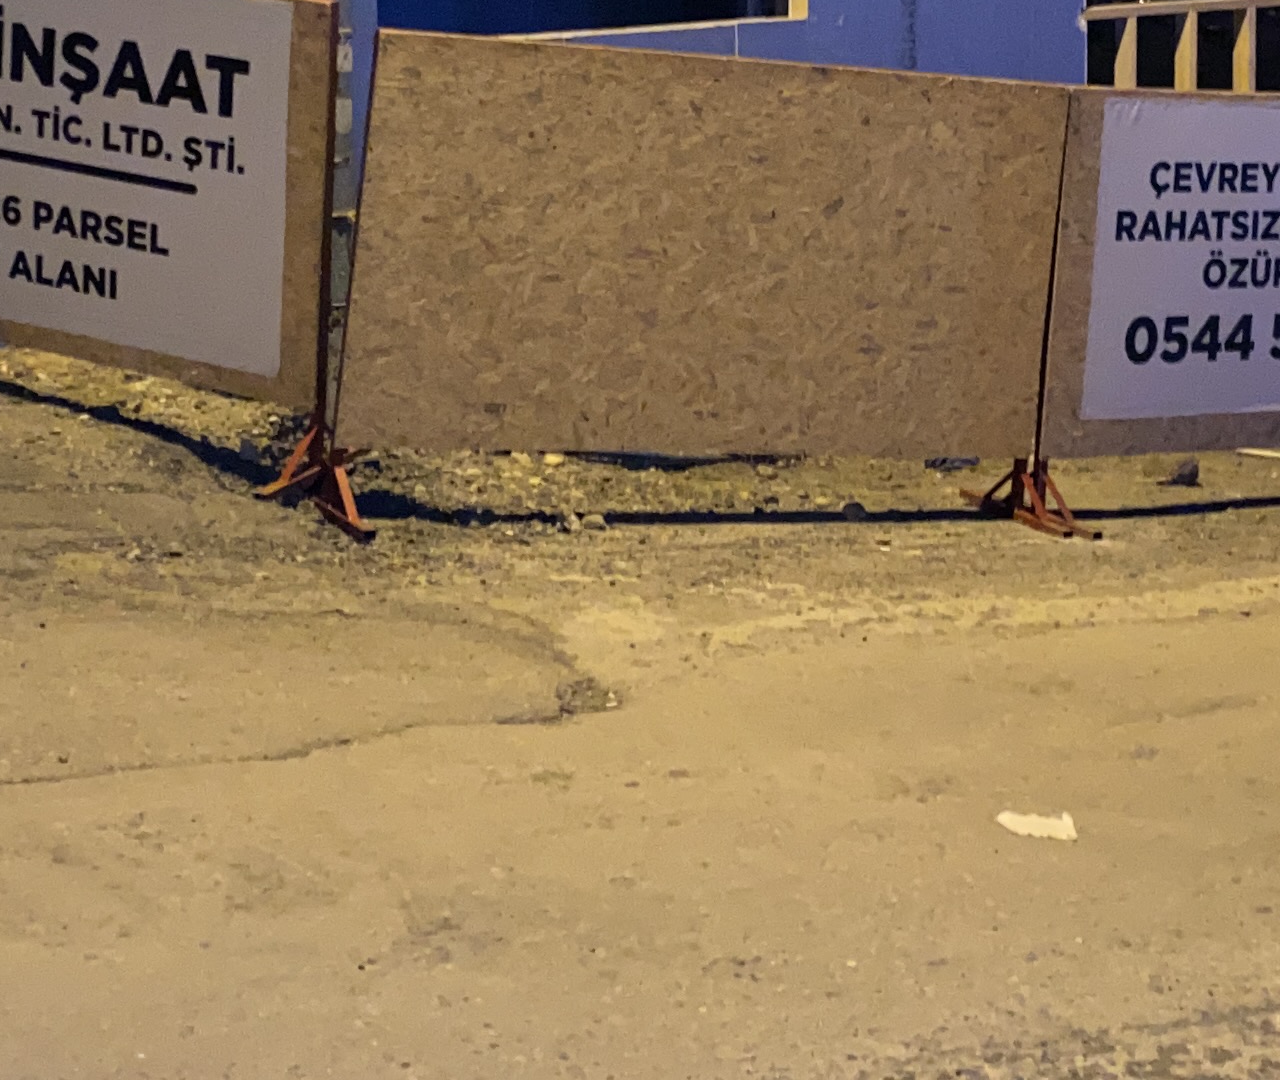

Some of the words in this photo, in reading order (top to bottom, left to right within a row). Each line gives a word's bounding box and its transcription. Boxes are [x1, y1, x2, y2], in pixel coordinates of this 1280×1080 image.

[31, 106, 92, 148] TİC.
[103, 121, 172, 162] LTD.
[182, 136, 246, 176] ŞTİ.
[33, 200, 170, 257] PARSEL
[9, 250, 119, 300] ALANI
[1124, 314, 1255, 365] 0544
